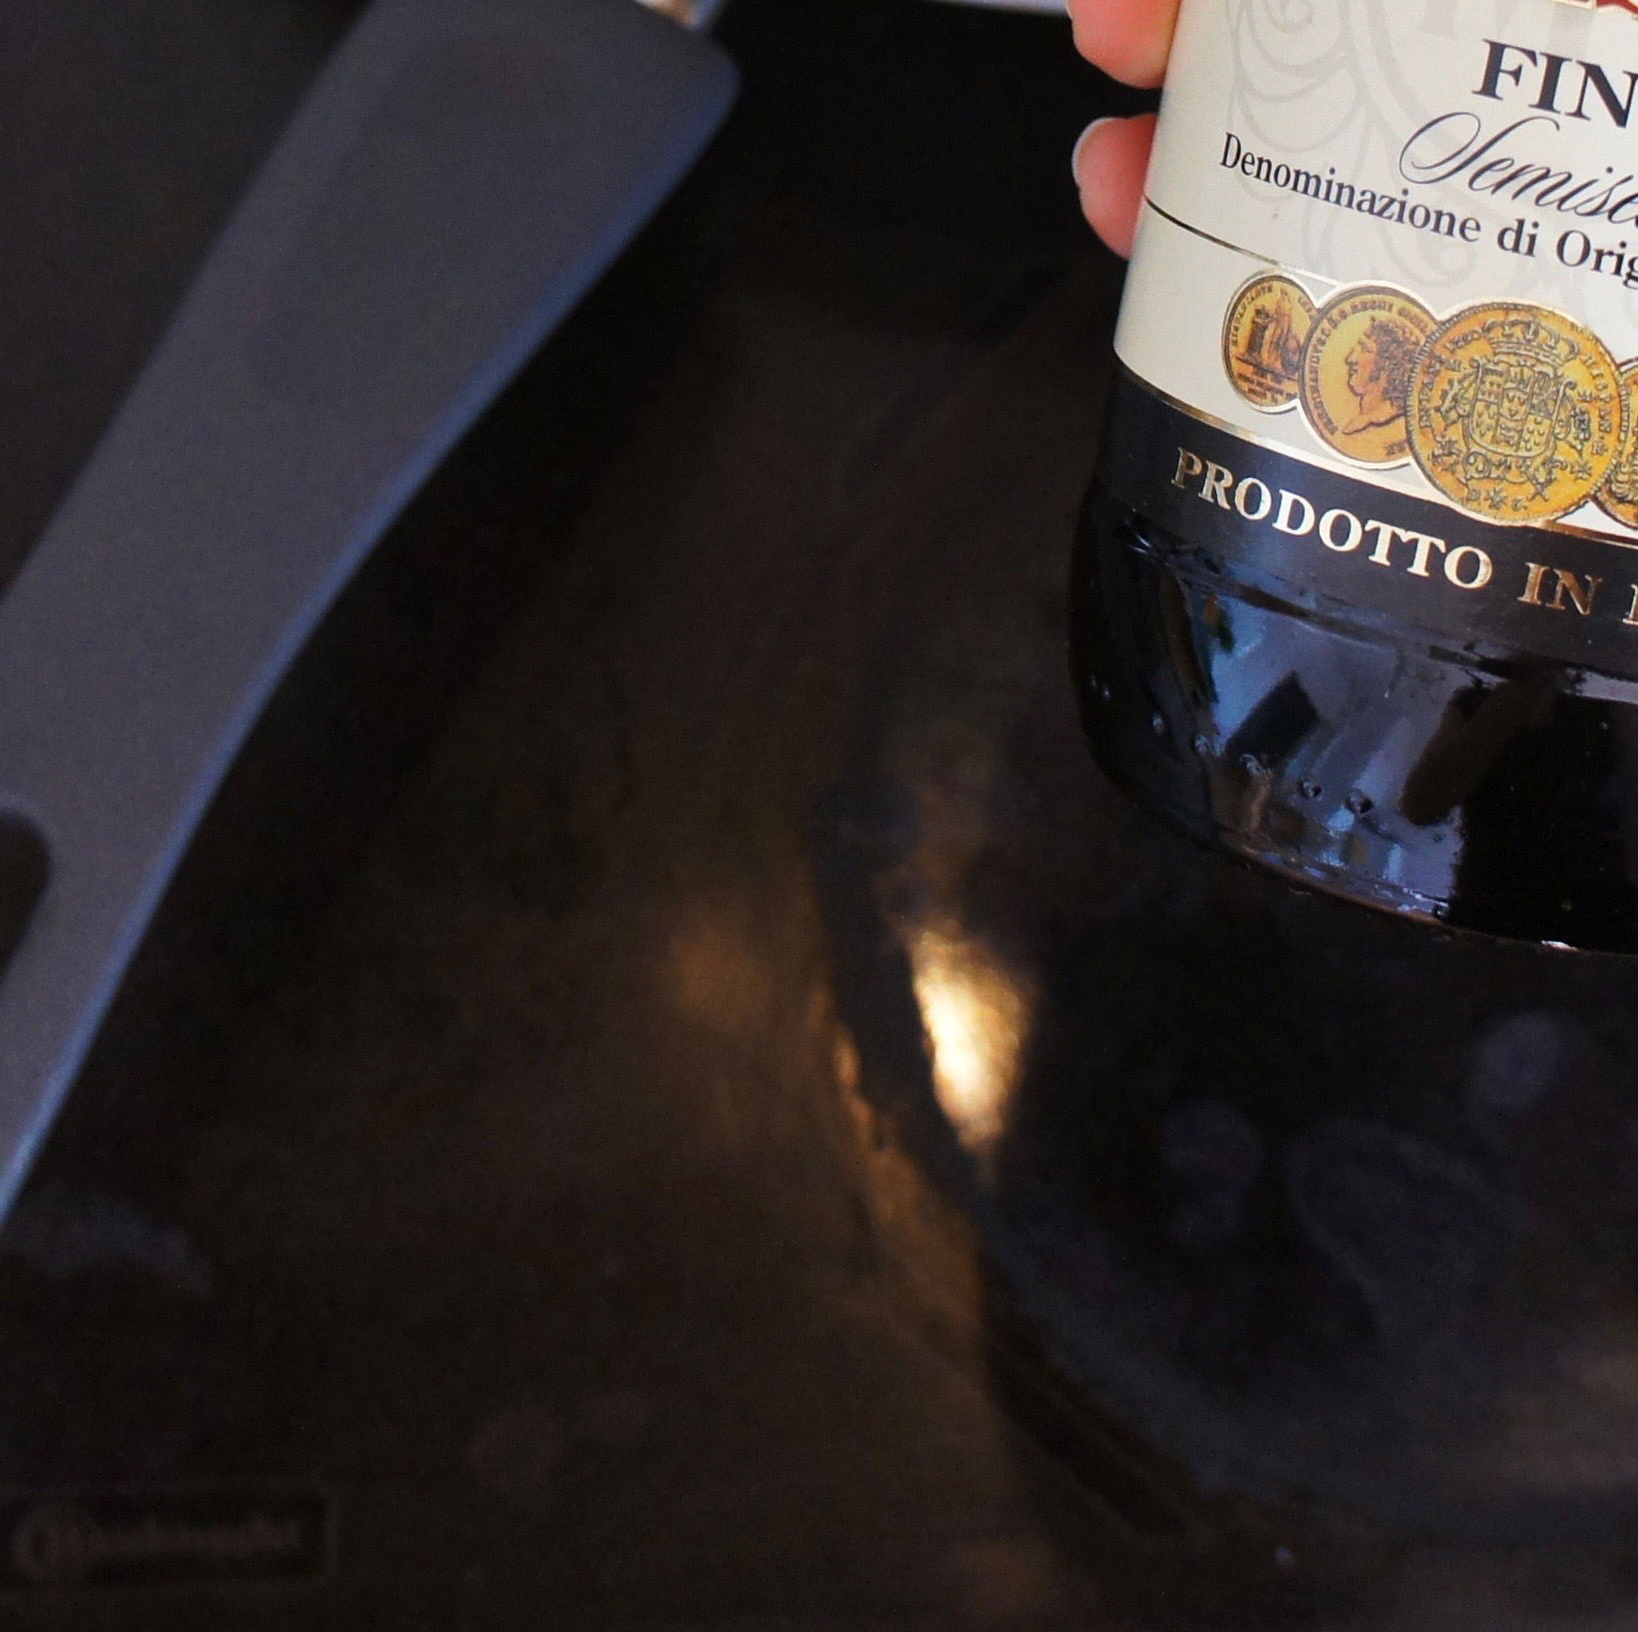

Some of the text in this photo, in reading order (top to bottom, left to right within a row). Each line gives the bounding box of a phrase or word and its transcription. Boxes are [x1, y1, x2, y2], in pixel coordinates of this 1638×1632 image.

[1218, 132, 1482, 244] Denominazione
[1496, 218, 1538, 259] di
[1171, 445, 1494, 590] PRODOTTO
[1518, 560, 1599, 617] IN
